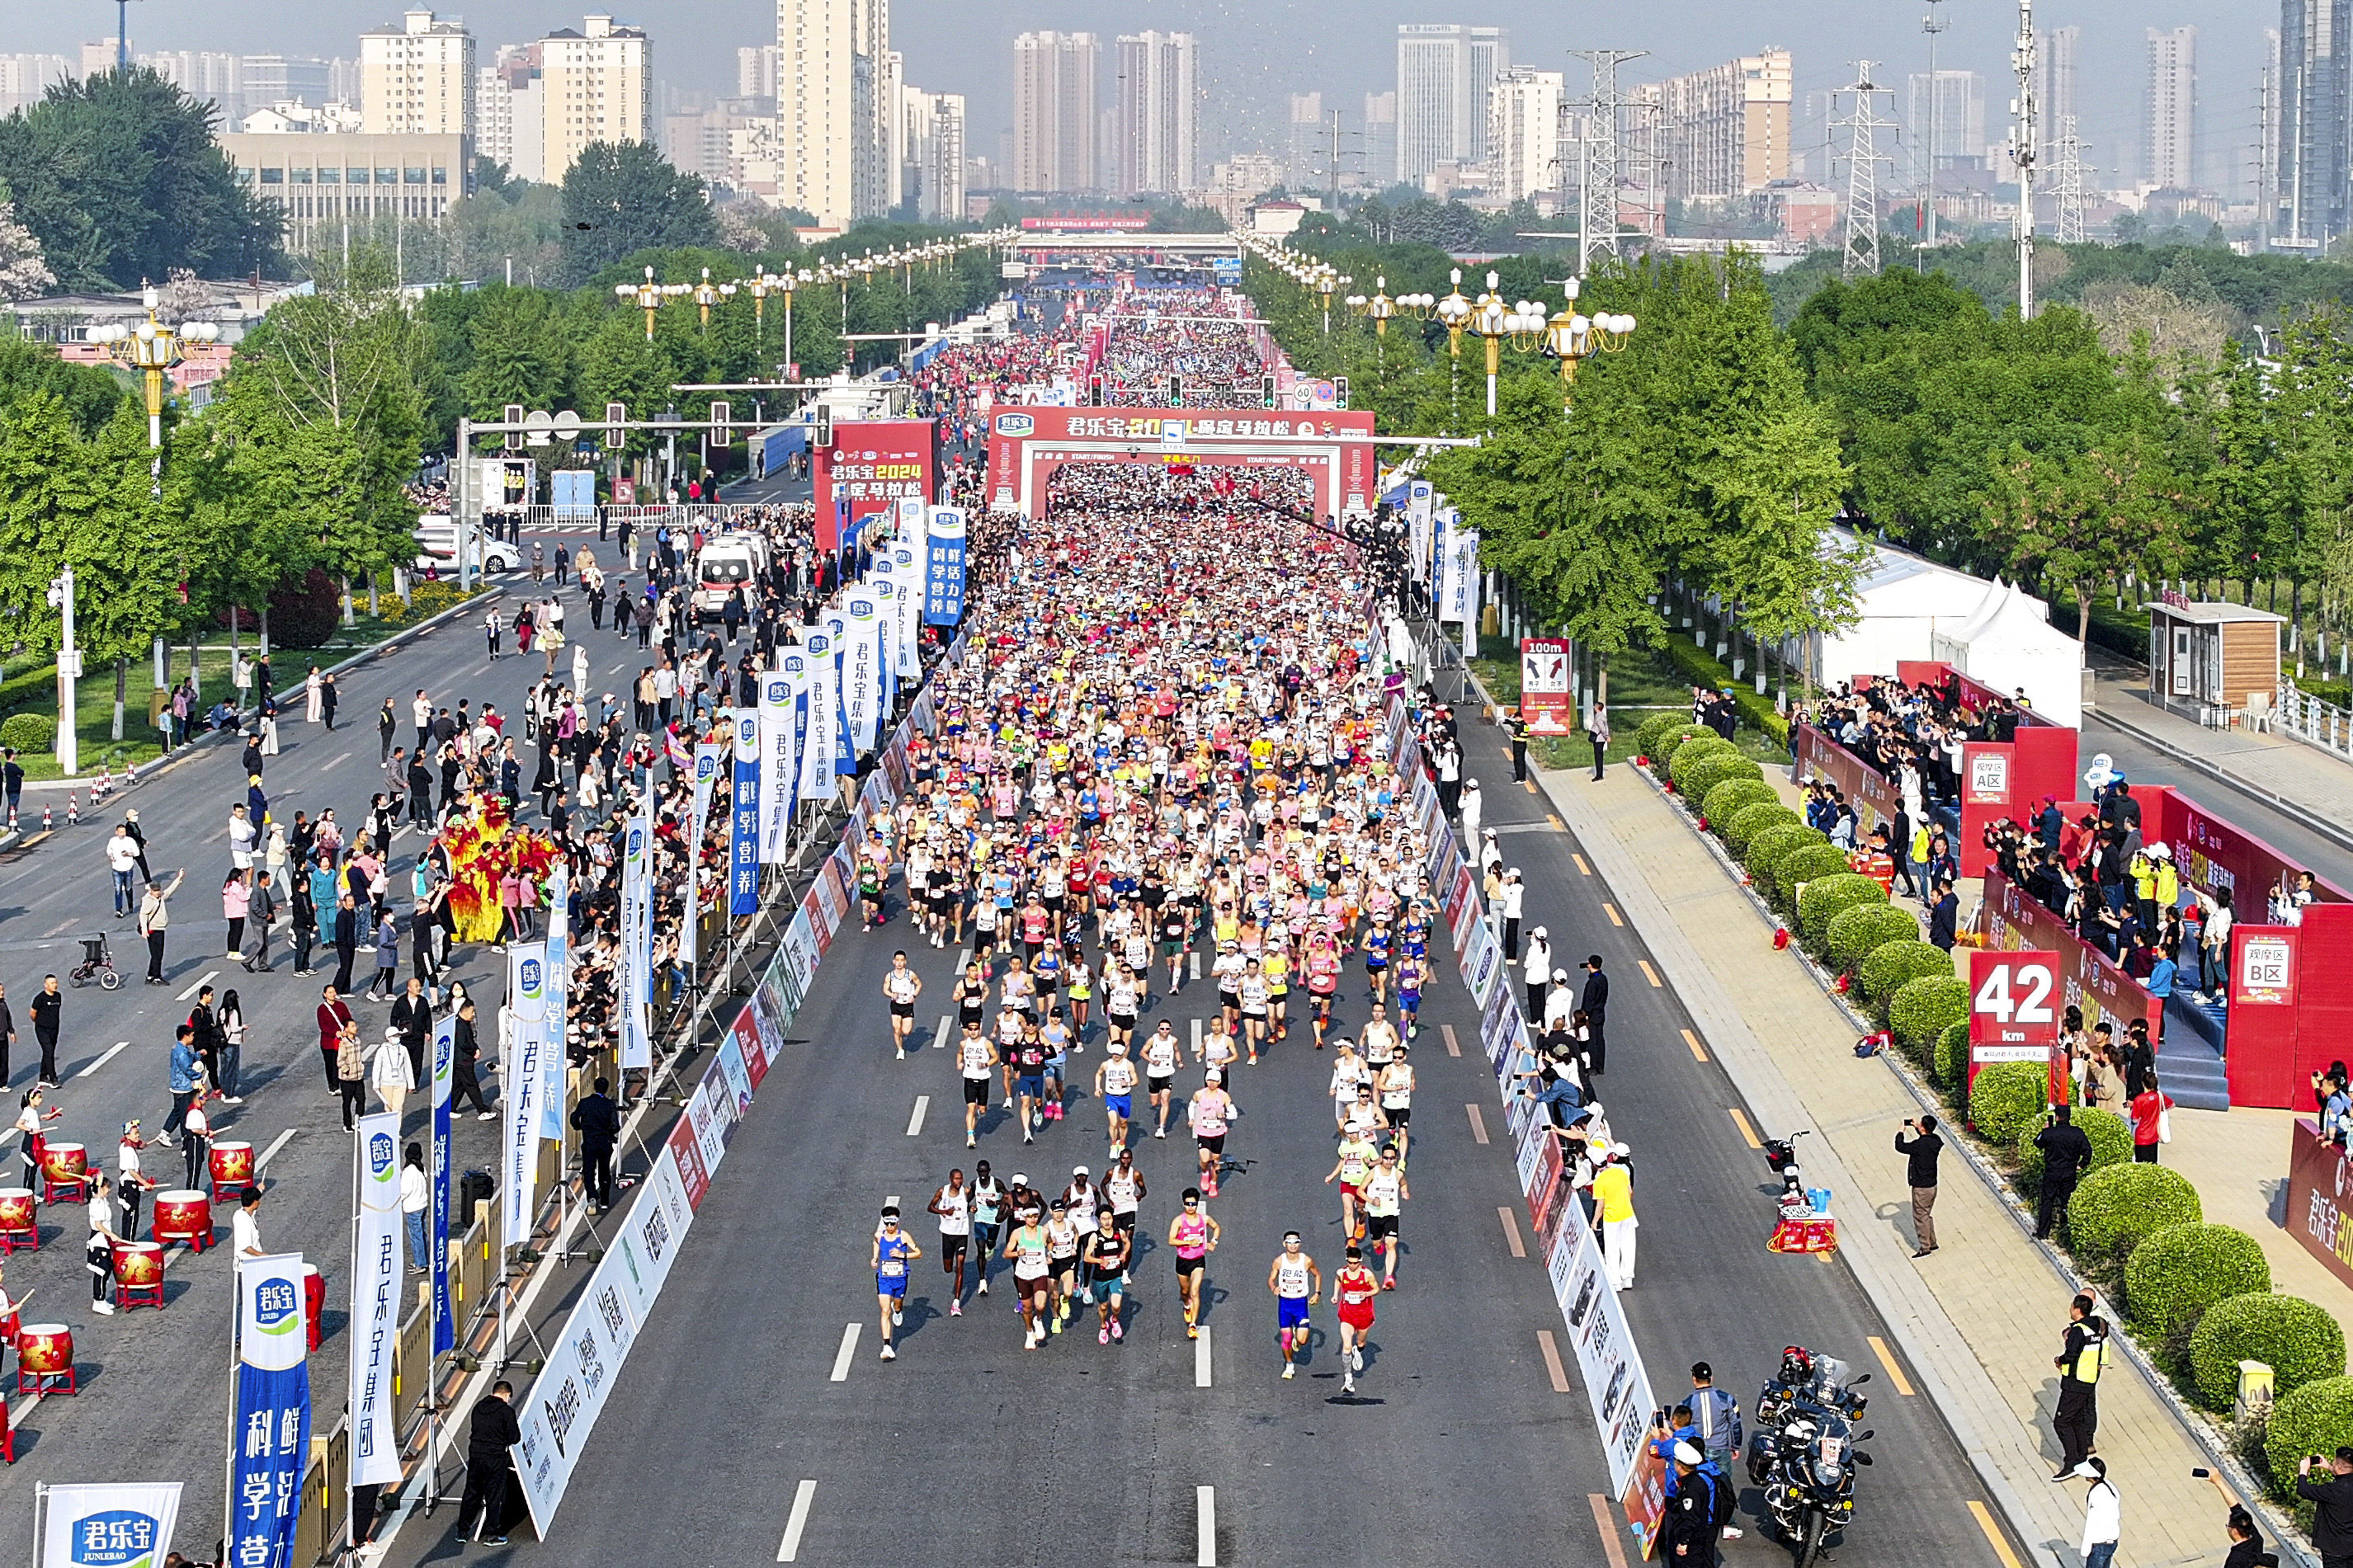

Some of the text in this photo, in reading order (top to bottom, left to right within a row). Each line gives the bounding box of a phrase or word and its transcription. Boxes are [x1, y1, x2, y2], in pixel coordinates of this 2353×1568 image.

[1297, 388, 1309, 398] 60
[931, 547, 945, 614] 科学营养
[946, 548, 961, 614] 鲜活力量
[1529, 643, 1563, 653] 100m
[1977, 774, 2001, 788] A区
[2249, 949, 2285, 961] 观摩区
[2251, 964, 2282, 982] B区
[1974, 964, 2053, 1023] 42
[2002, 1029, 2025, 1042] km
[370, 1137, 393, 1163] 君乐宝
[260, 1284, 295, 1311] 君乐宝
[358, 1234, 393, 1459] 君乐宝集团
[83, 1519, 152, 1550] 君乐宝
[83, 1552, 127, 1562] JUNLEBAO
